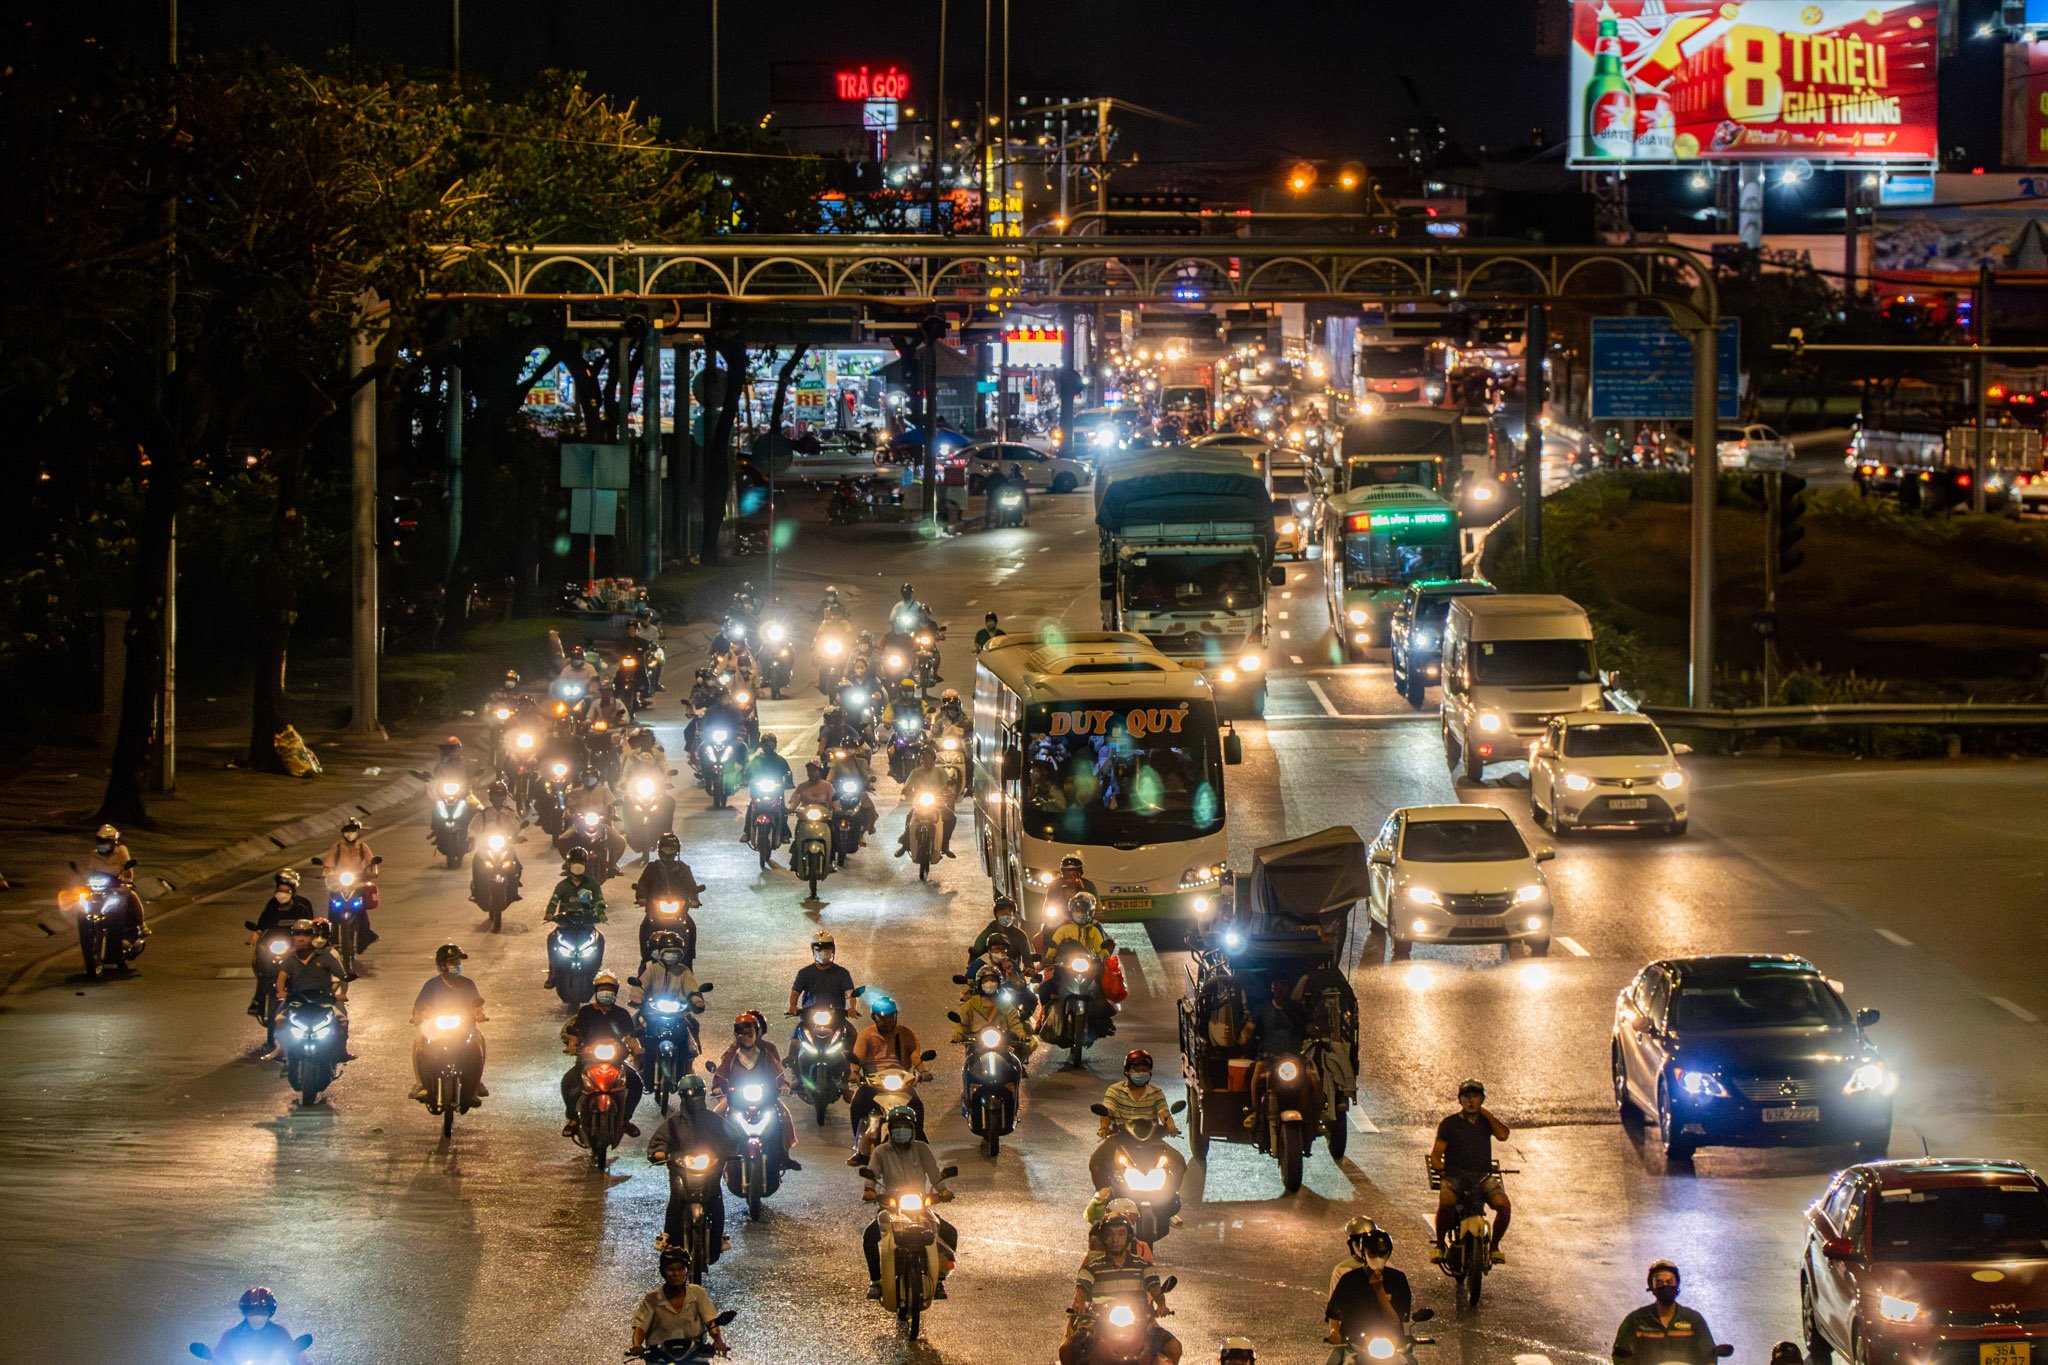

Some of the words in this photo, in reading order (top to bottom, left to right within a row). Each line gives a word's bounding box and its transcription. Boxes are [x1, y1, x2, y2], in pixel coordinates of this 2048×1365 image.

[837, 65, 869, 99] TRẢ
[872, 66, 908, 99] GÓP
[1725, 24, 1783, 123] 8
[1782, 84, 1825, 124] GIẢI
[1050, 709, 1113, 736] DUY
